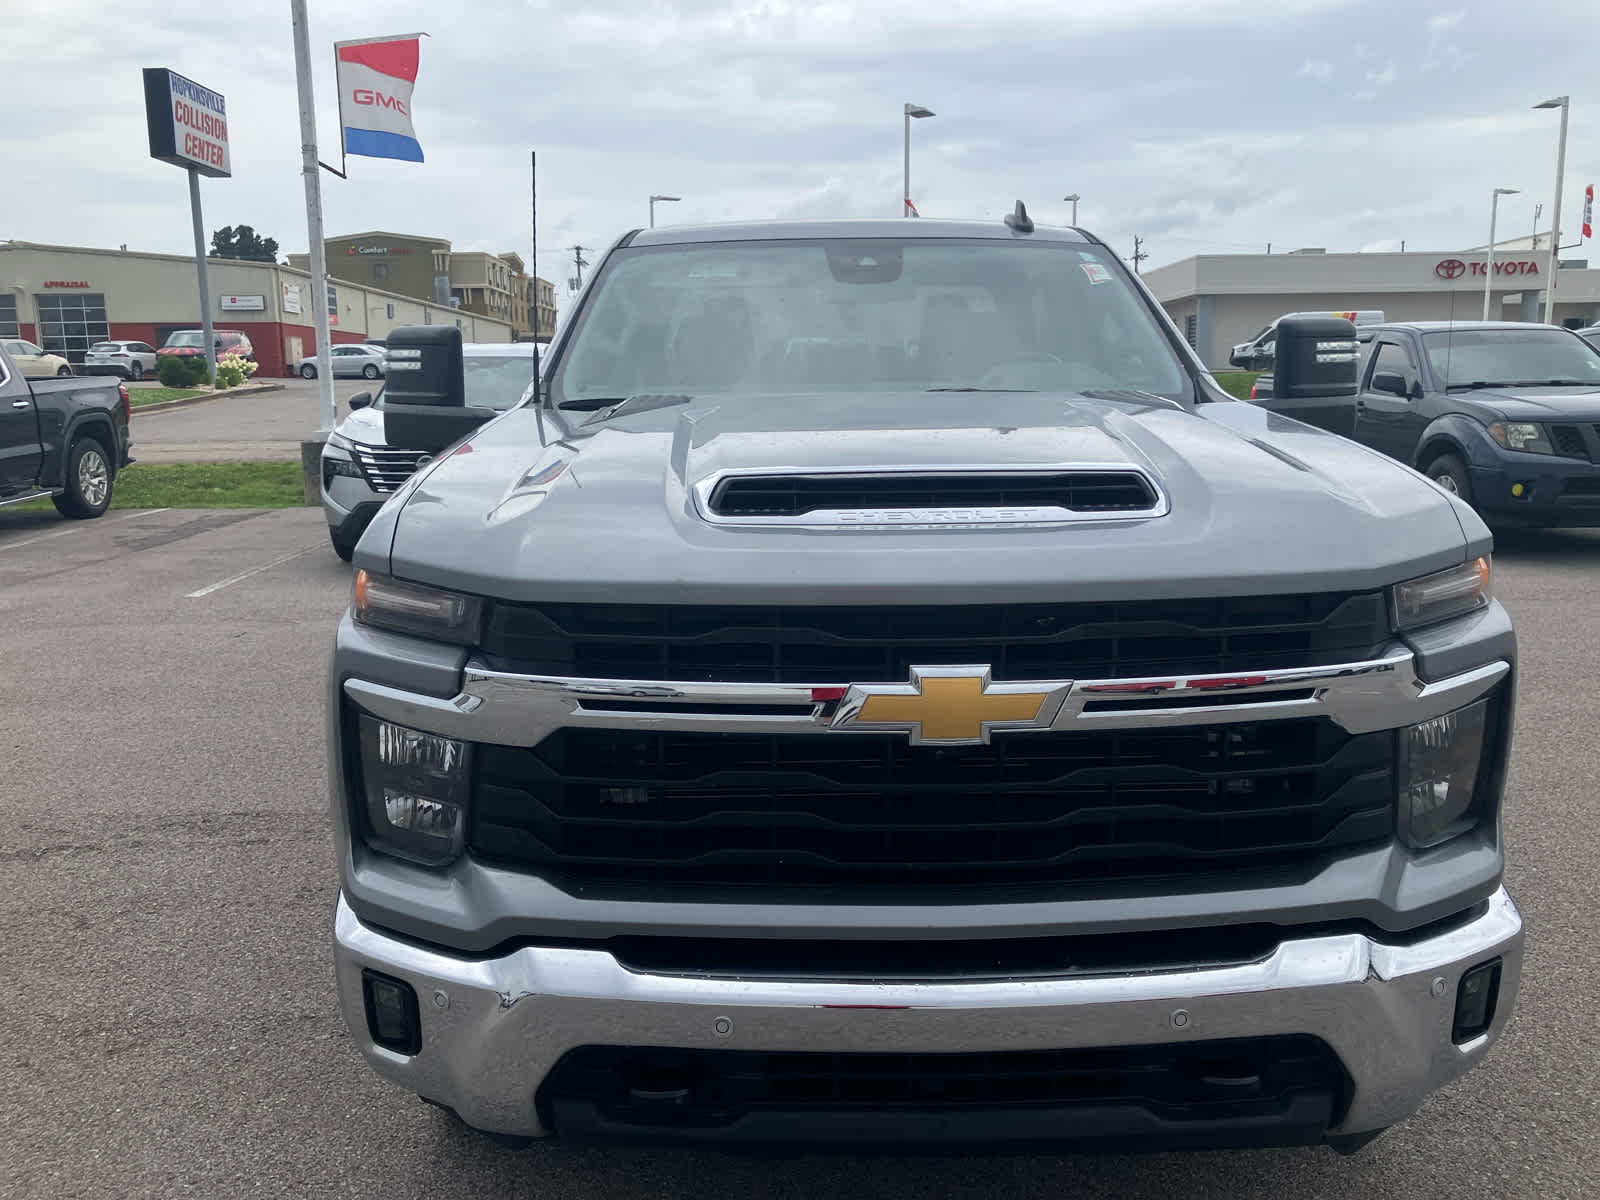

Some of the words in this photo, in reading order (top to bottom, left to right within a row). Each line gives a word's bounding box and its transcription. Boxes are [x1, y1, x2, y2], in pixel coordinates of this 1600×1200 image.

[170, 74, 225, 116] HOPKINSVILLE
[353, 89, 408, 117] GMC
[175, 100, 228, 142] COLLISION
[184, 132, 224, 168] CENTER
